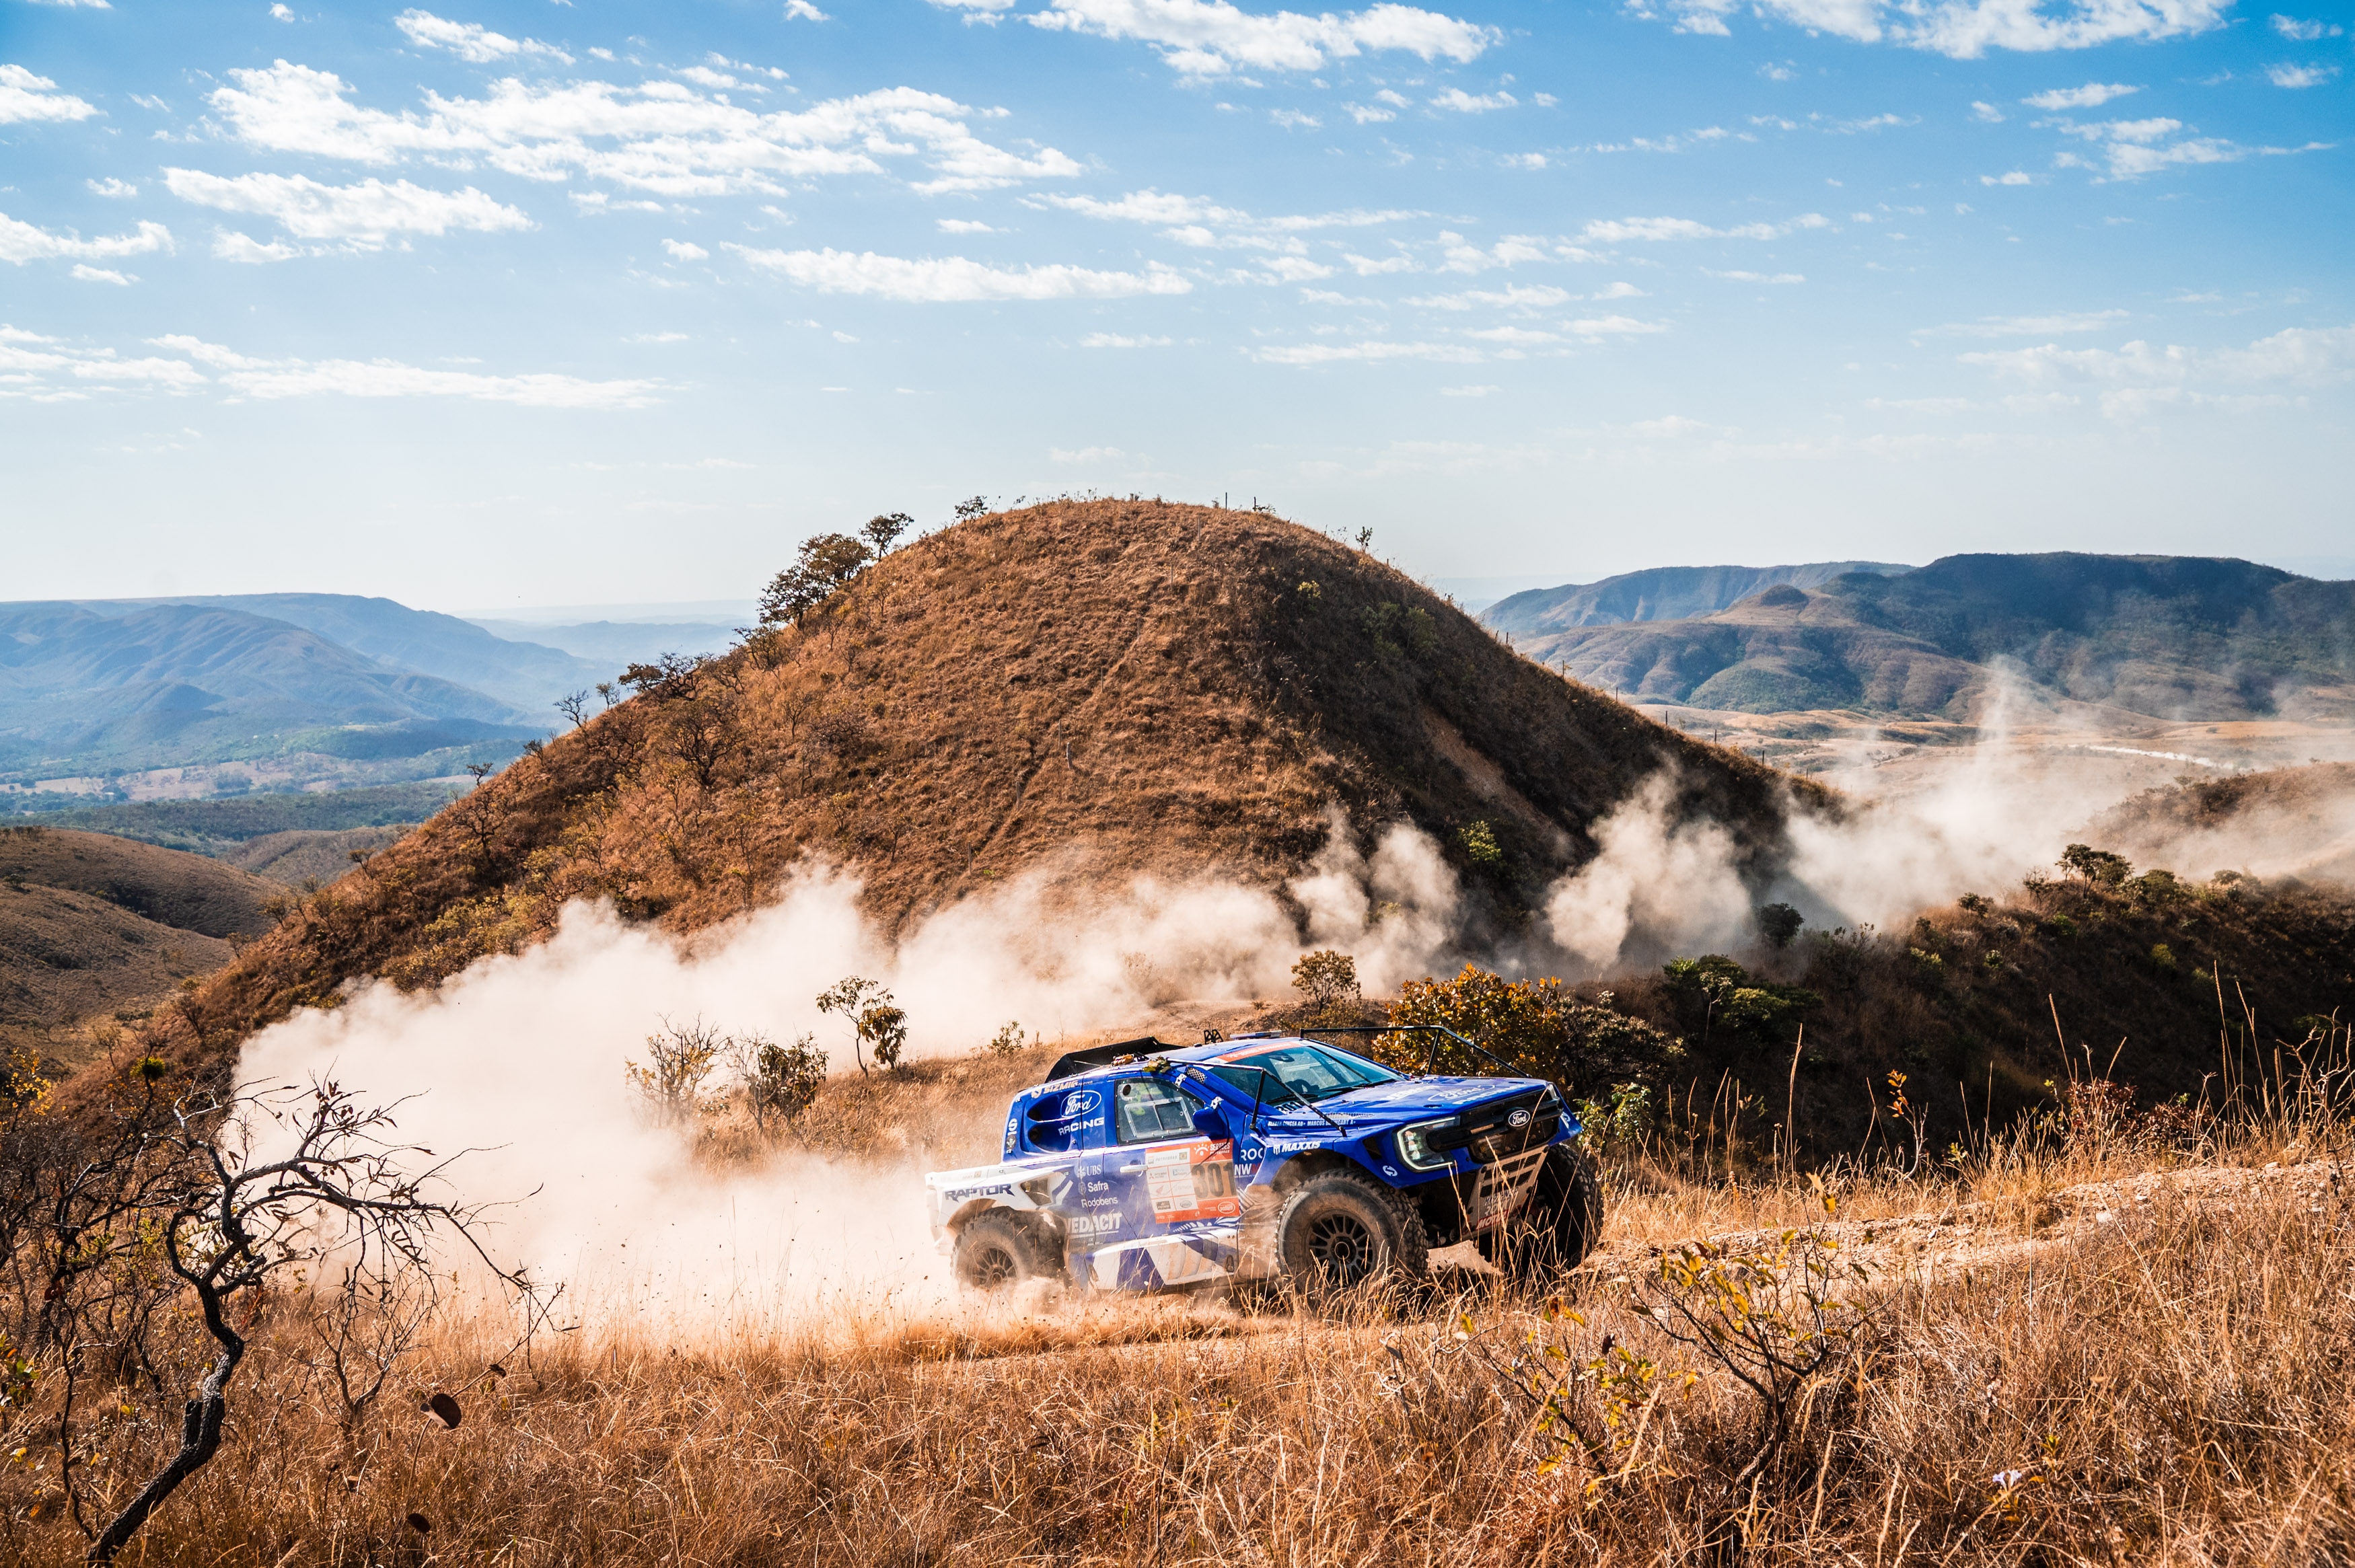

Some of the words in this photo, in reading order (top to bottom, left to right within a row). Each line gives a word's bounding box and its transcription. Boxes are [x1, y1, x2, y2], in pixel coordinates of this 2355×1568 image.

[1064, 1094, 1093, 1116] Ford
[1512, 1112, 1527, 1125] Ford
[1058, 1117, 1105, 1135] RACING
[1281, 1141, 1321, 1152] MAXXIS
[1087, 1164, 1101, 1176] UBS
[1087, 1181, 1109, 1193] Safra
[1192, 1162, 1237, 1199] 301
[945, 1184, 1015, 1203] RAPTOR
[1081, 1197, 1118, 1208] Rodobens
